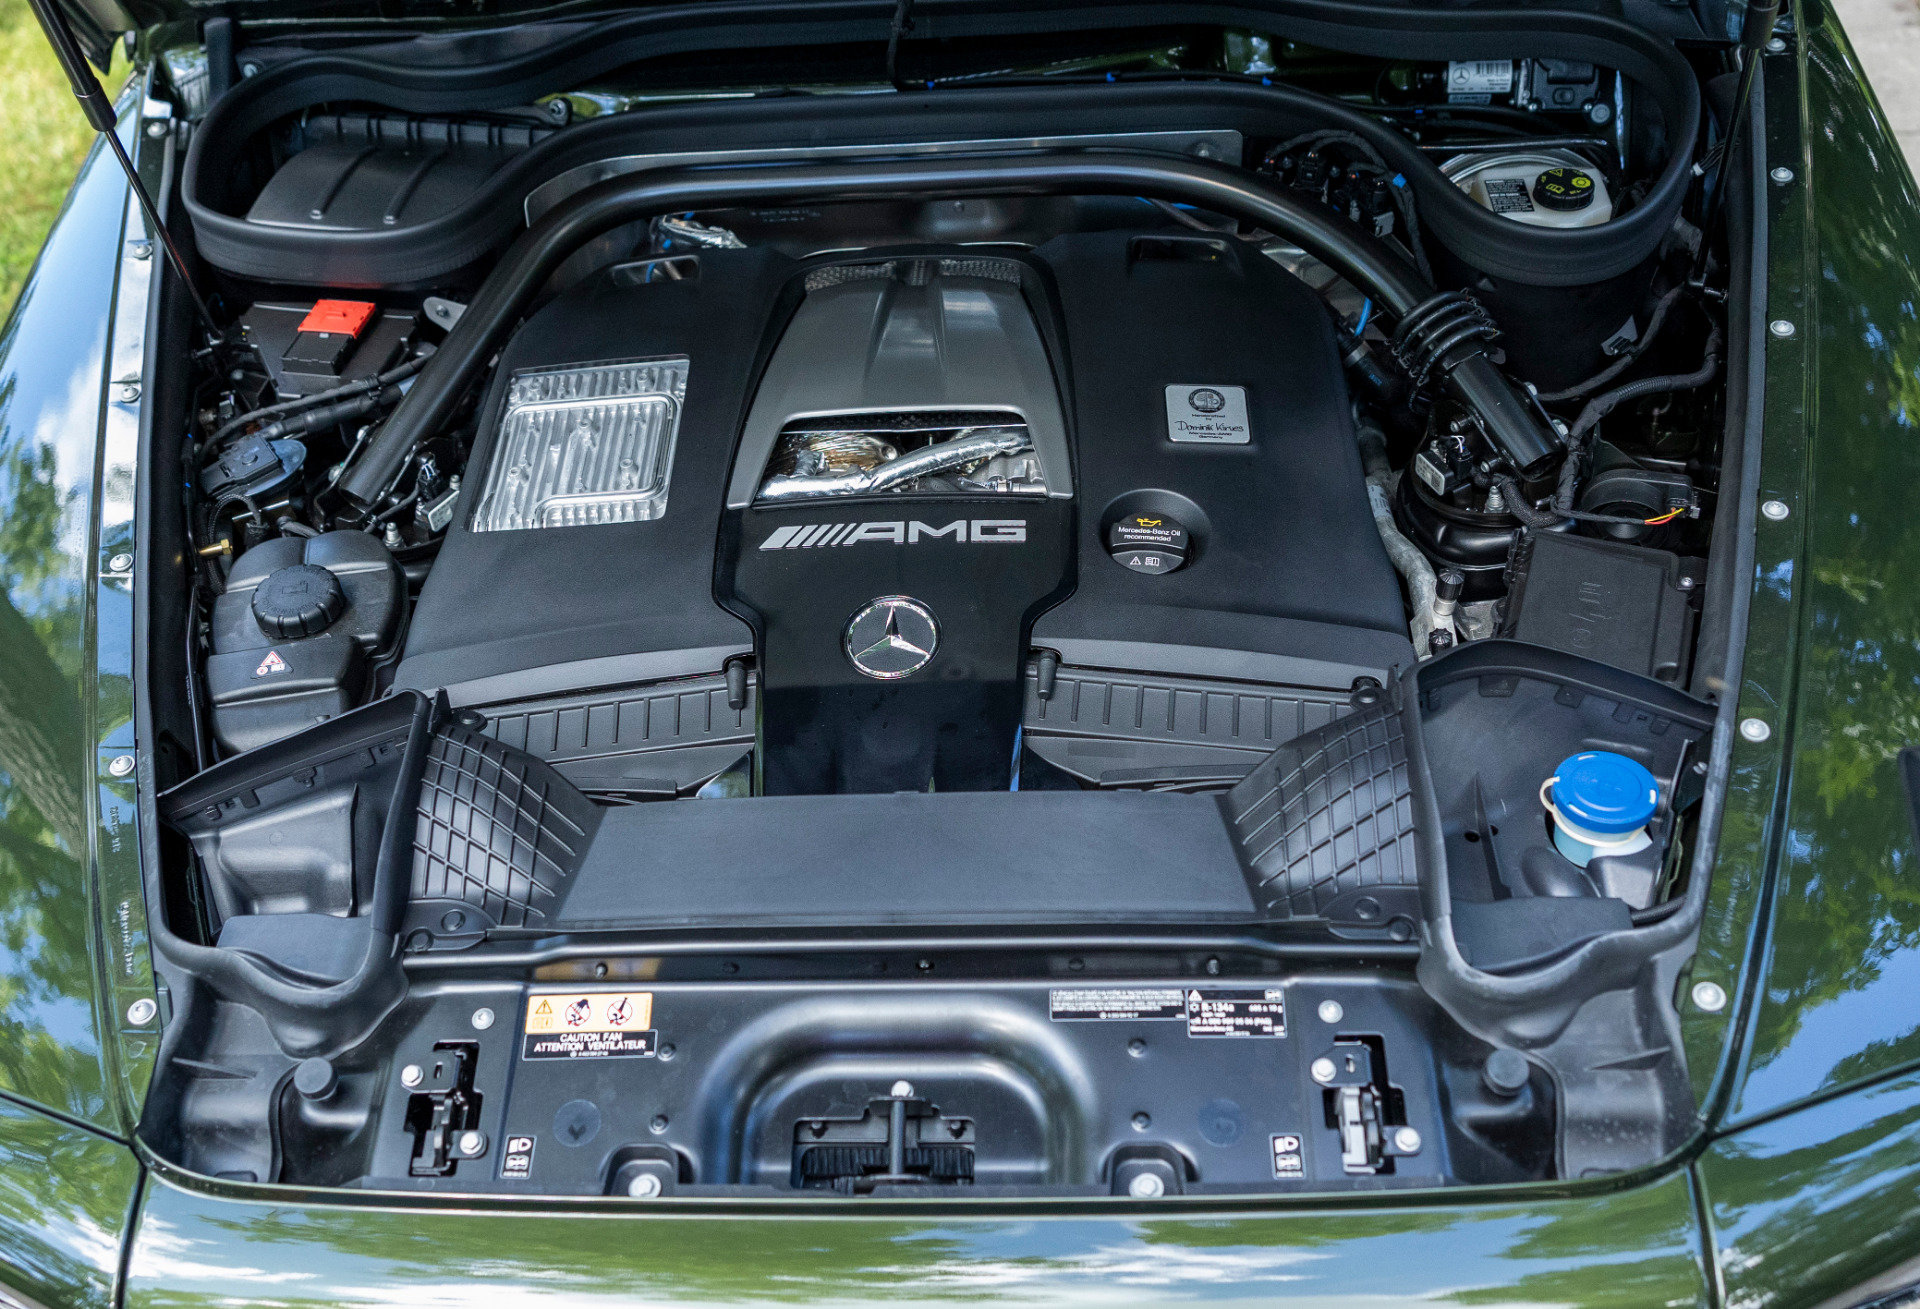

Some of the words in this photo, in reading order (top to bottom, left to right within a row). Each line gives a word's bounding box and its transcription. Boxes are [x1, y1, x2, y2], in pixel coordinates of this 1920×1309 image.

[1174, 420, 1214, 431] Dominik
[843, 519, 1027, 545] AMG
[1118, 526, 1170, 536] Mercedes-Benz
[1123, 534, 1172, 542] recommended
[1201, 1001, 1235, 1012] R-134a
[560, 1032, 600, 1043] CAUTION
[603, 1031, 623, 1041] FAN
[533, 1041, 585, 1053] ATTENTION
[588, 1039, 646, 1051] VENTILATEUR
